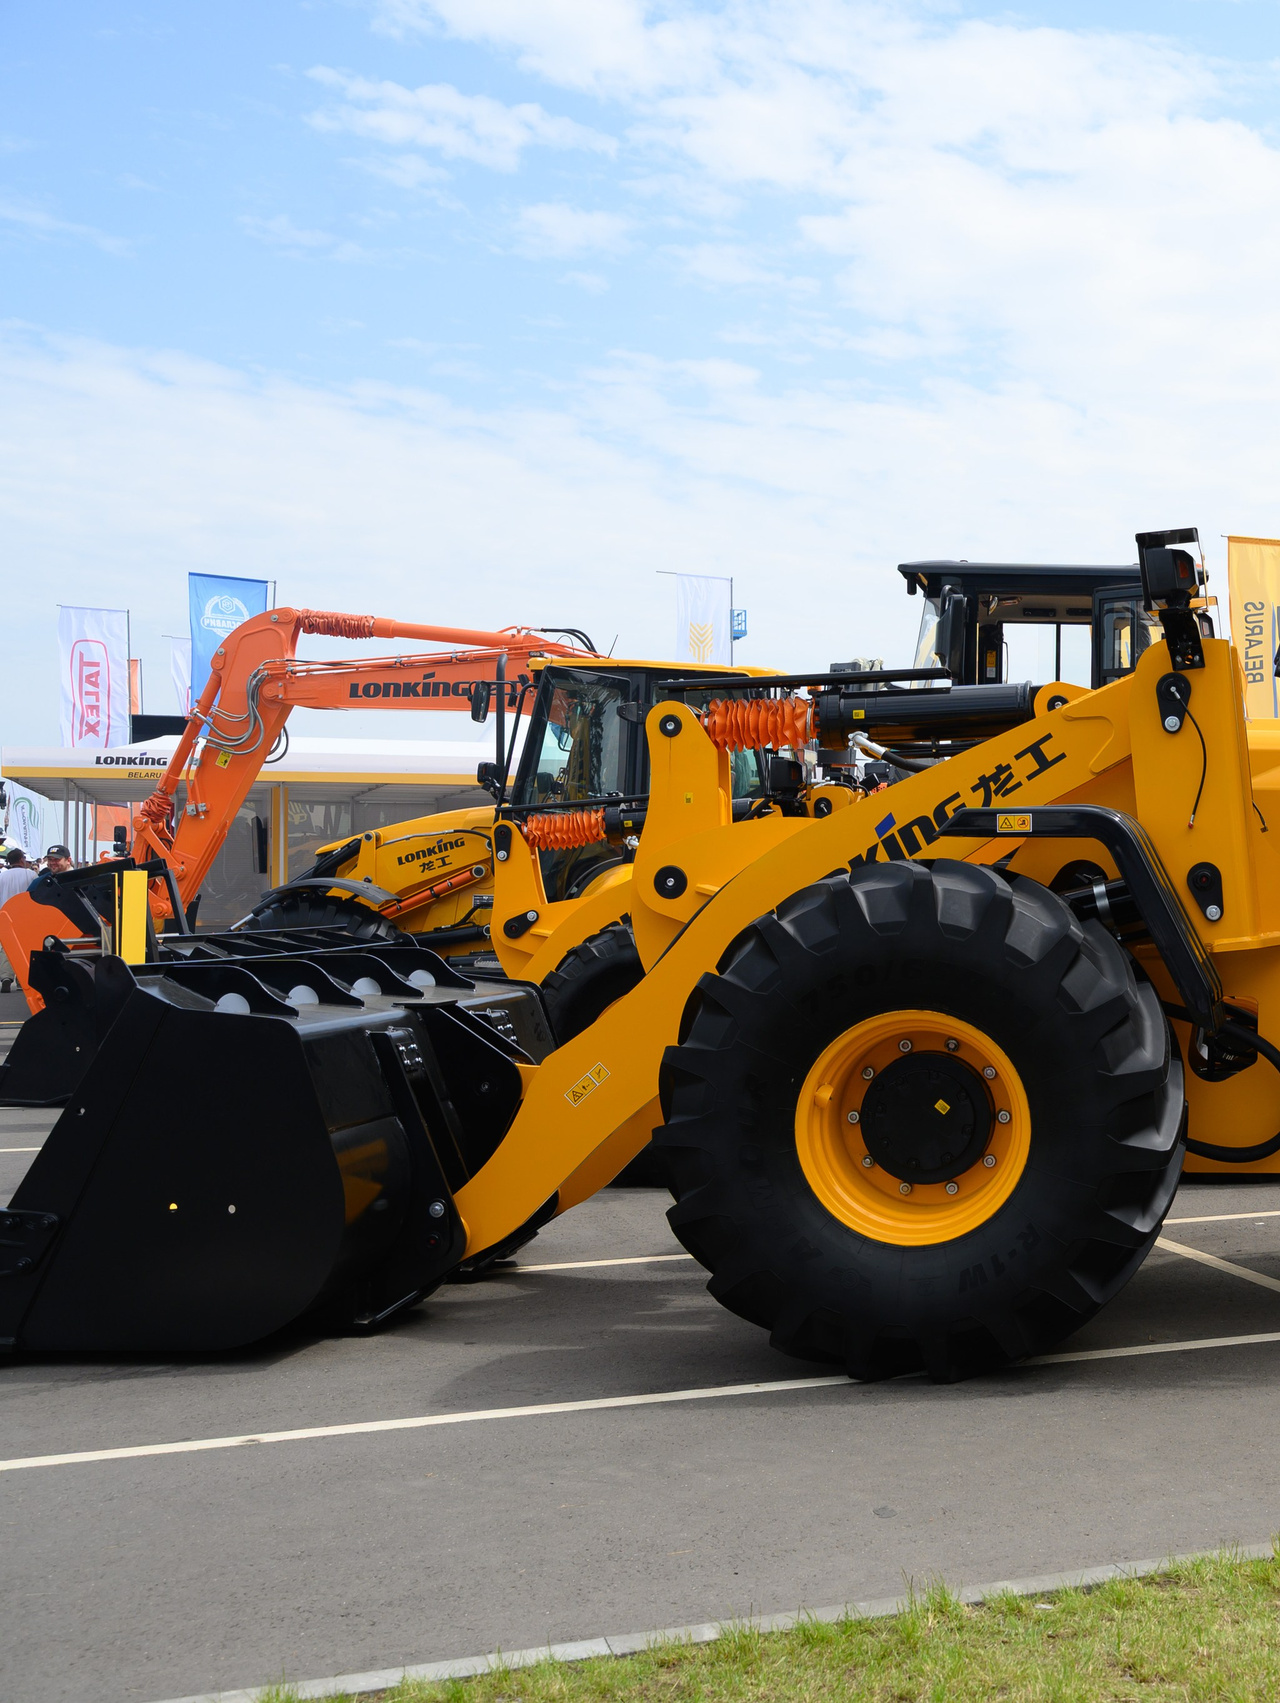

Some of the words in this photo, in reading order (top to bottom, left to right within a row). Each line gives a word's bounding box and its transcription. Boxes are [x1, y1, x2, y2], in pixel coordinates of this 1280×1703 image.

[95, 752, 168, 766] LONKING
[970, 732, 1067, 807] 龙工
[127, 771, 162, 779] BELARU
[396, 836, 465, 866] LONKING
